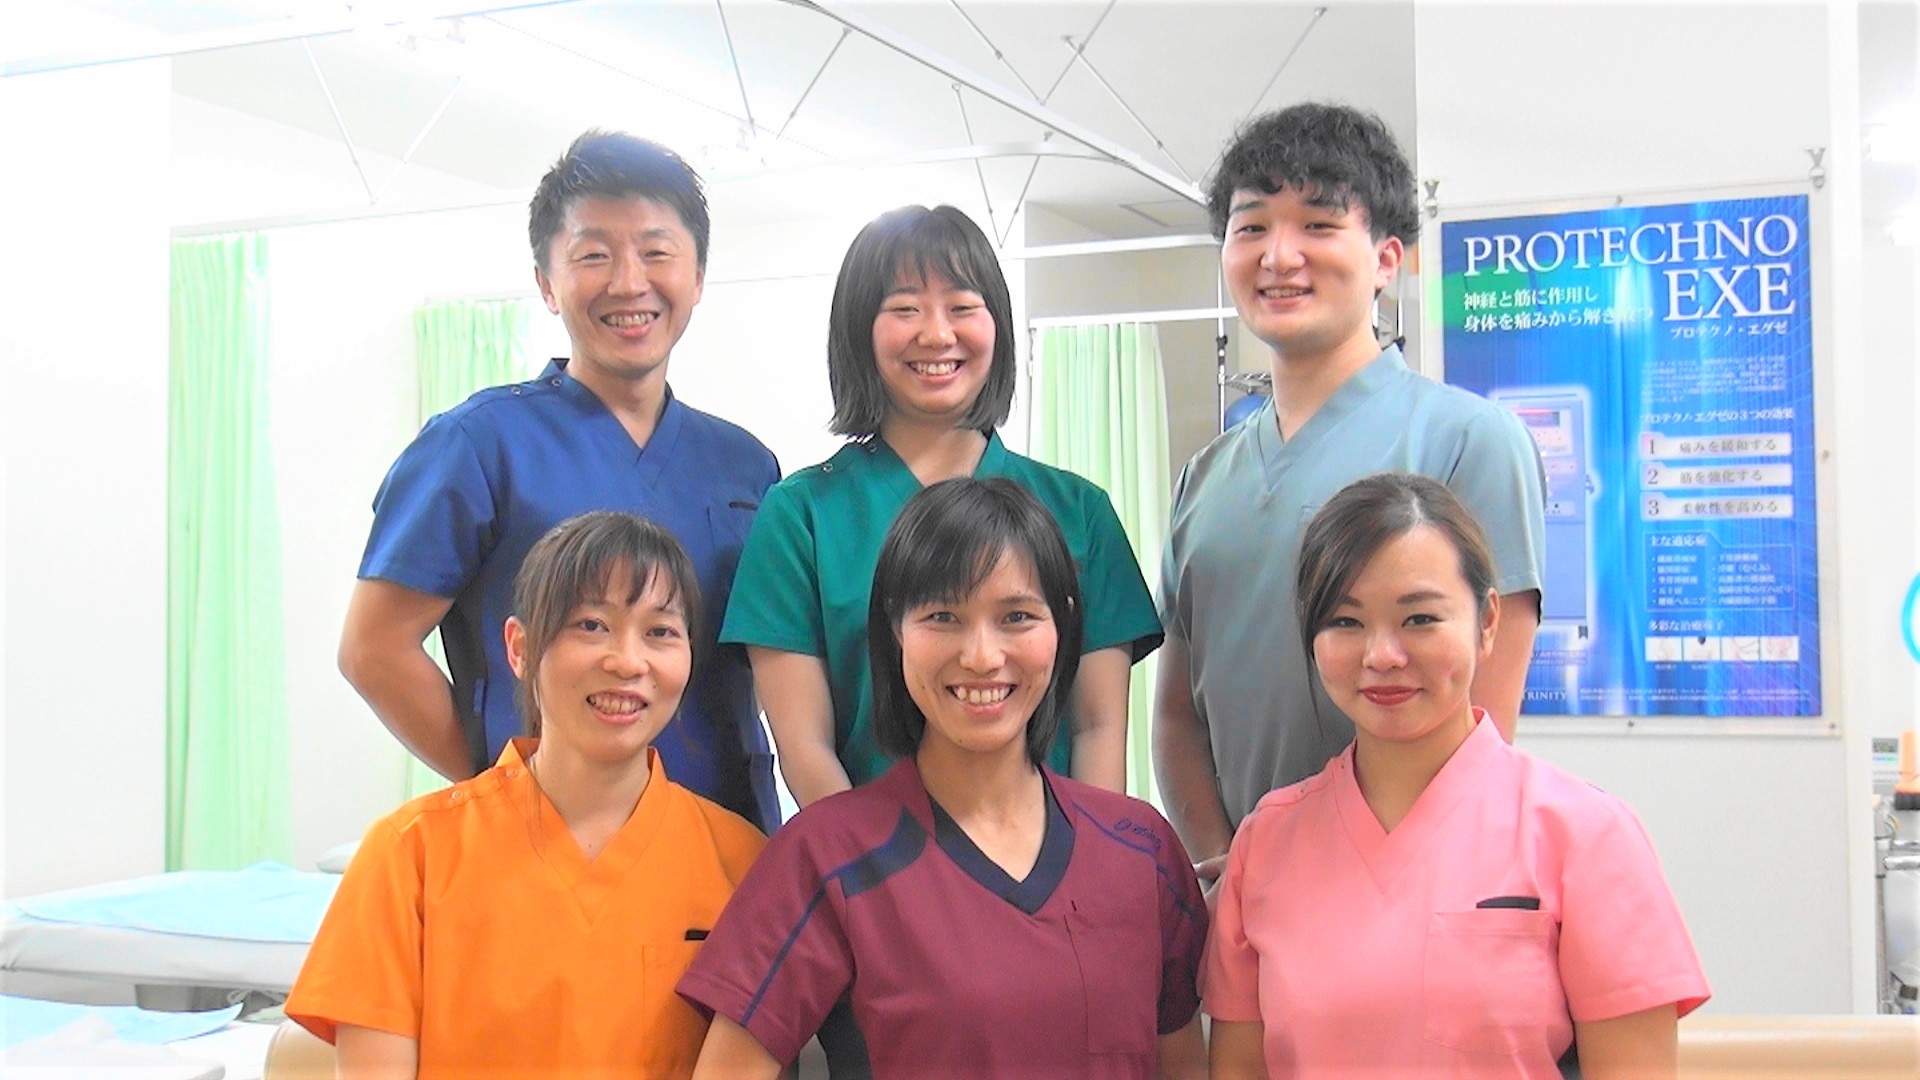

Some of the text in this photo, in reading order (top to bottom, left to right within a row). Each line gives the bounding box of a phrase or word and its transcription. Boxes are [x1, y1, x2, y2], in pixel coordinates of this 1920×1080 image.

[1463, 214, 1798, 277] PROTECHNO
[1464, 286, 1599, 310] 神経と筋に作用し
[1663, 262, 1795, 322] EXE
[1649, 438, 1776, 455] 1 痛みを緩和する
[1647, 469, 1762, 485] 2 筋を強化する
[1648, 500, 1778, 516] 3 柔軟性を高める
[1525, 690, 1568, 701] RINITY
